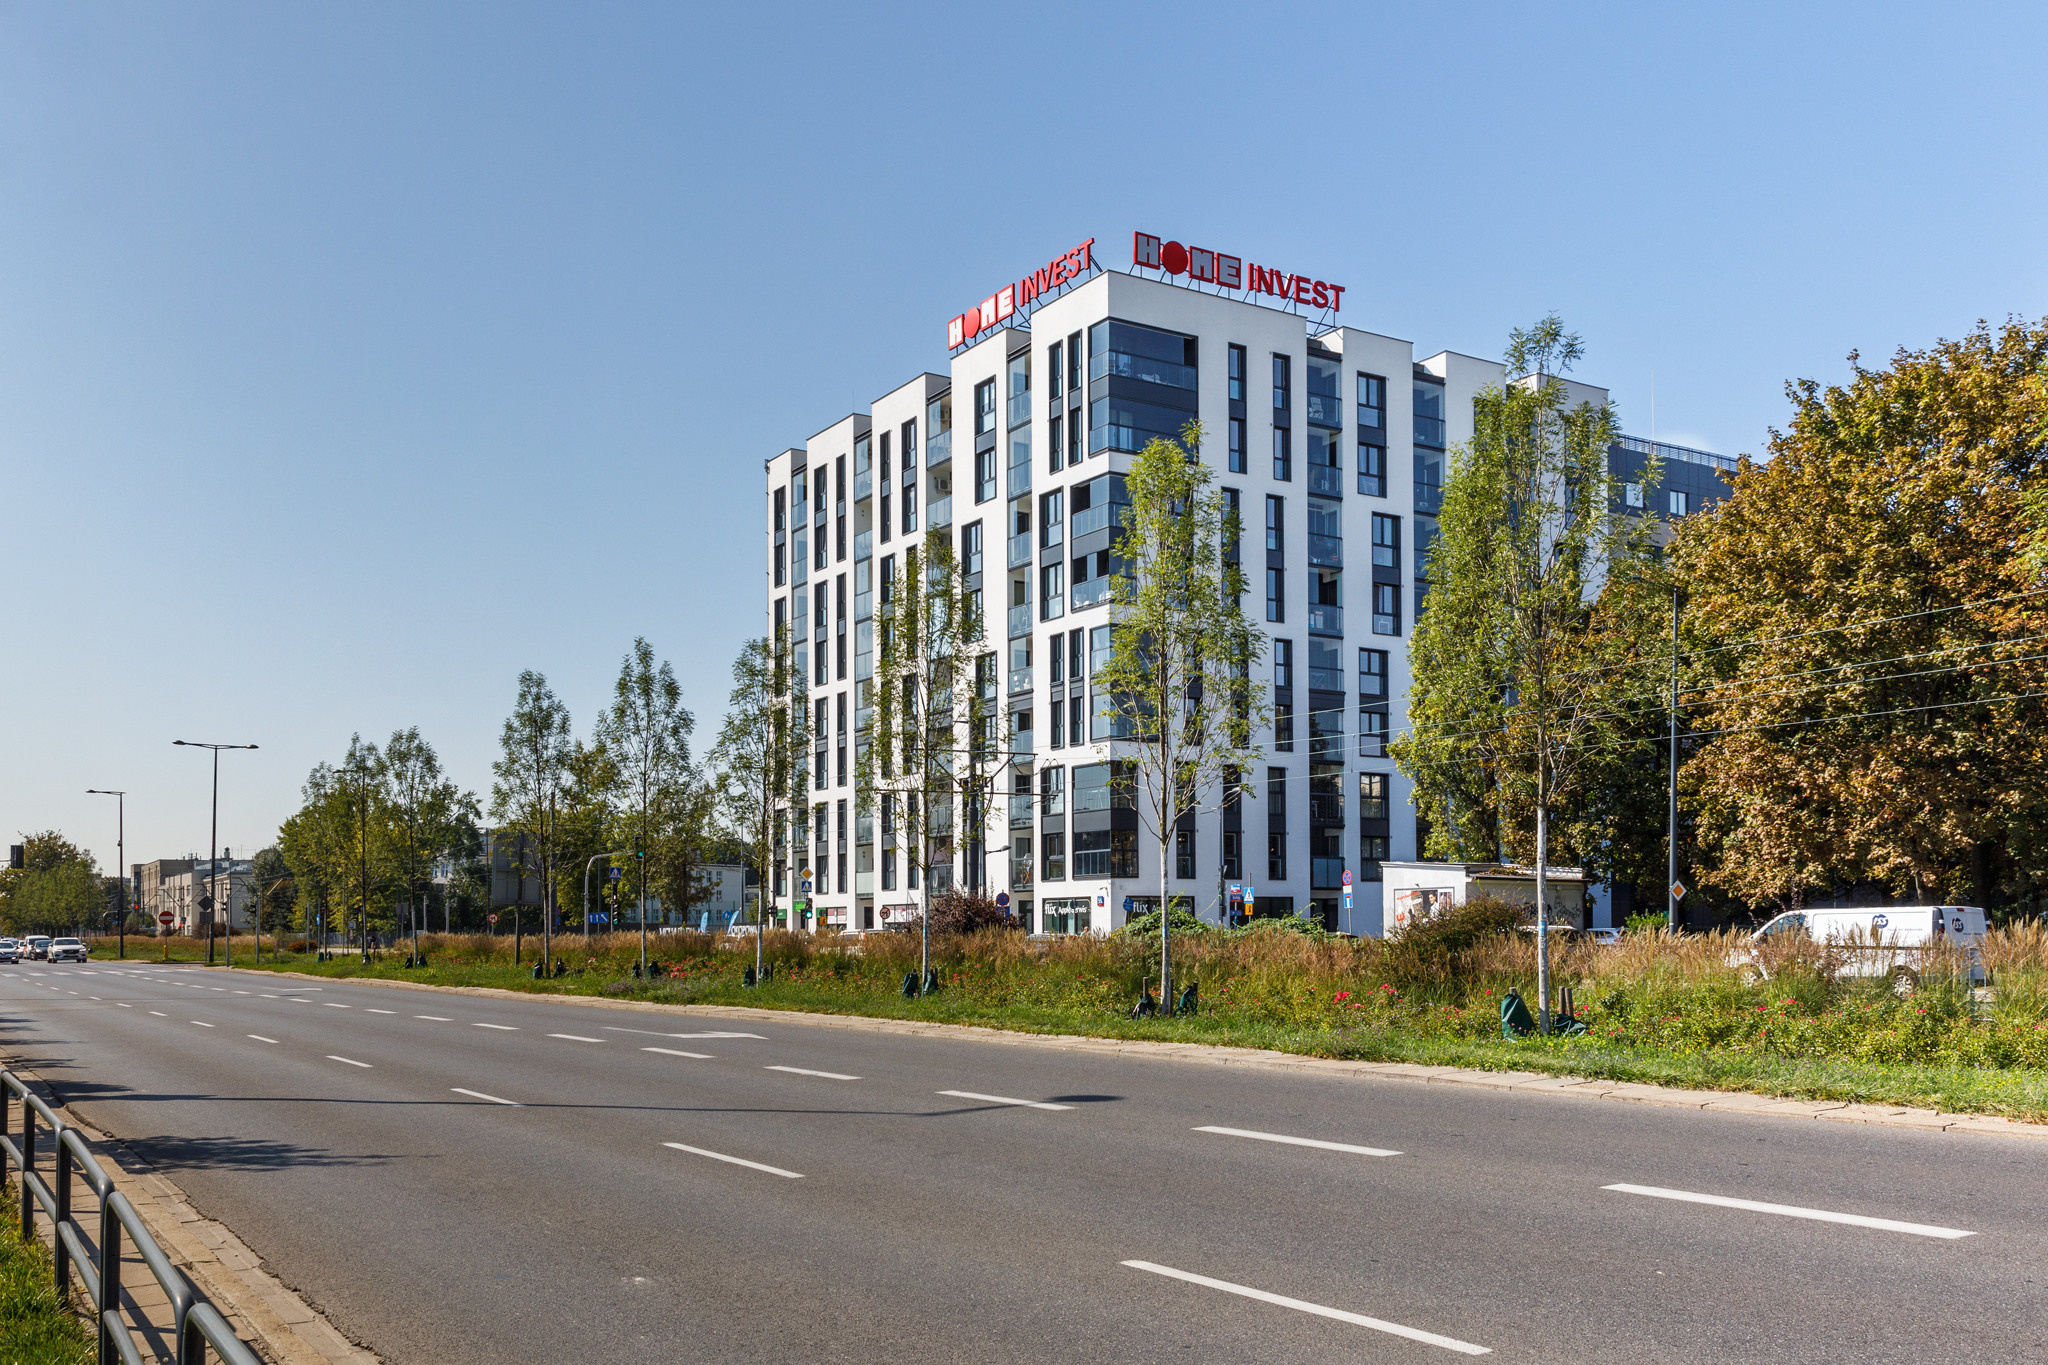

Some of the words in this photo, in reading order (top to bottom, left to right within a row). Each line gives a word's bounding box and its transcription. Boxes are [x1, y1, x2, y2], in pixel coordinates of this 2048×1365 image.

[947, 282, 1016, 350] HOME
[1019, 237, 1095, 307] INVEST
[1133, 230, 1242, 290] HOME
[1247, 262, 1346, 313] INVEST
[1133, 901, 1150, 917] flix
